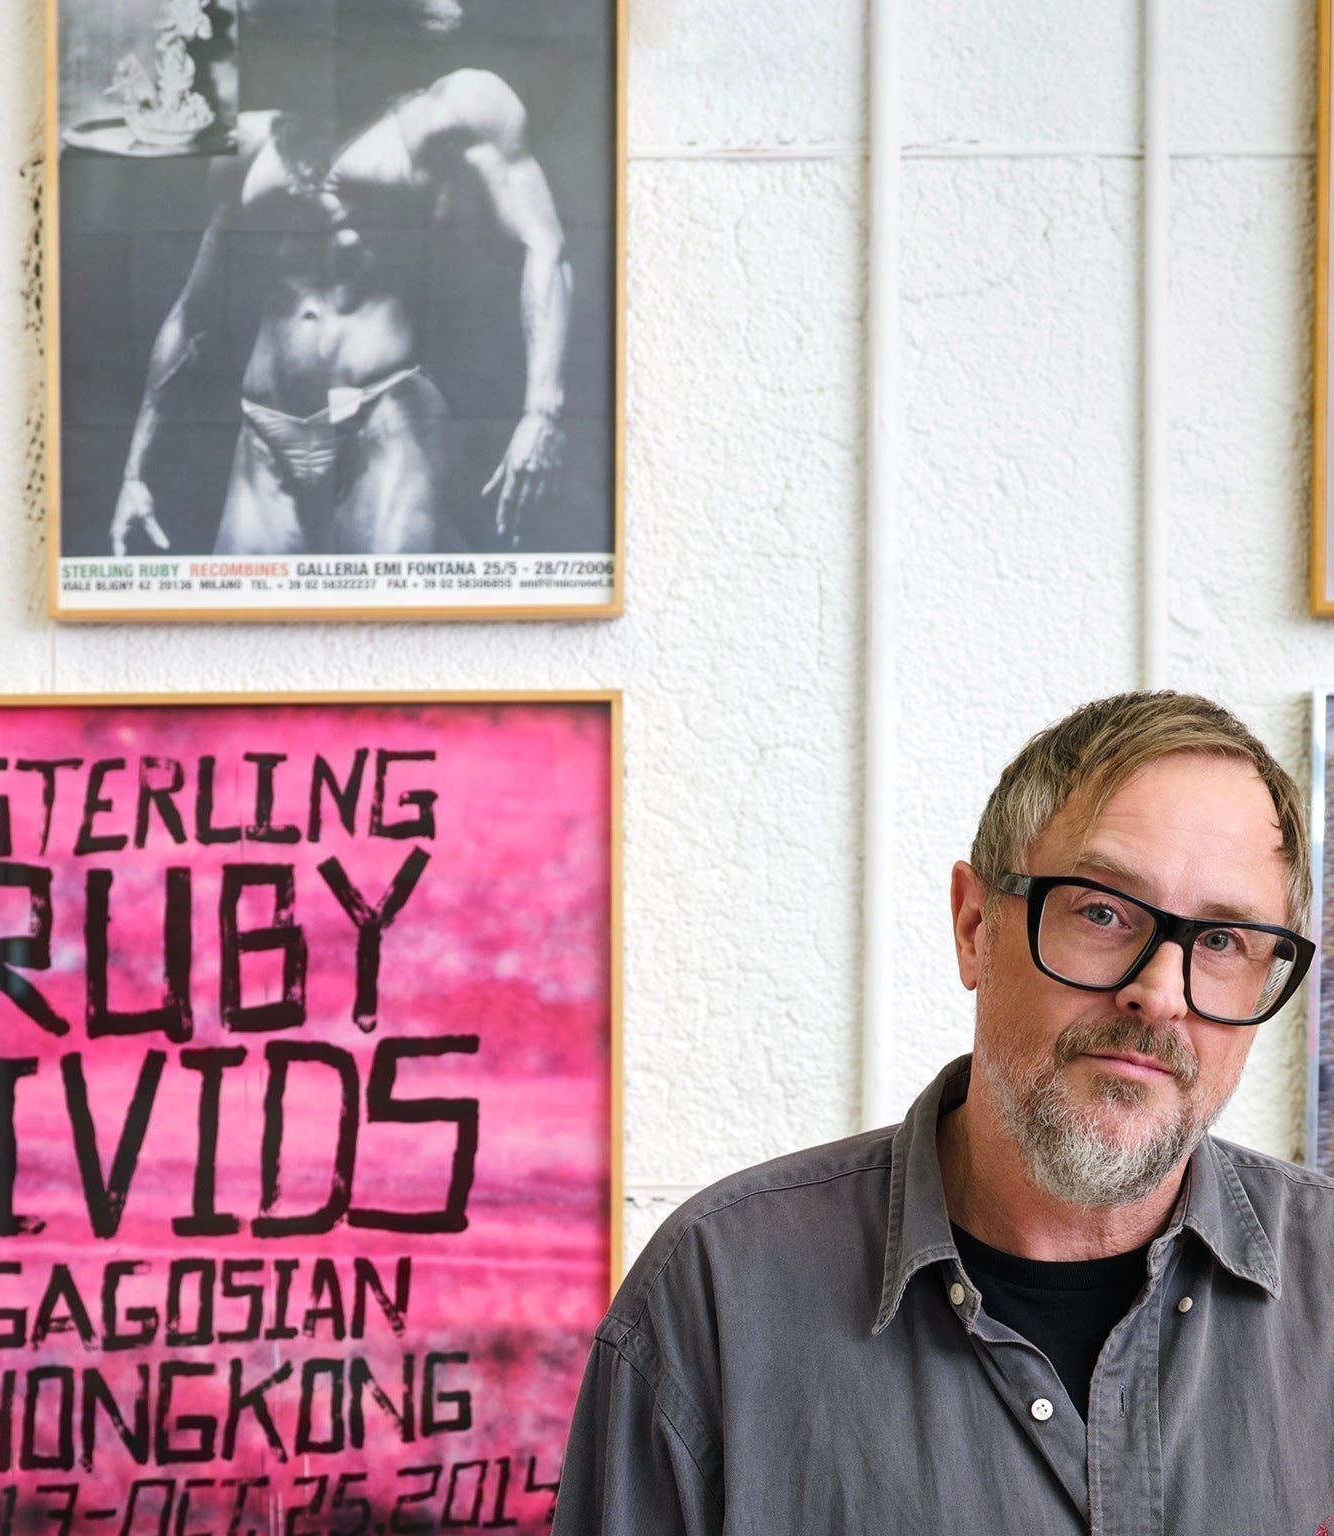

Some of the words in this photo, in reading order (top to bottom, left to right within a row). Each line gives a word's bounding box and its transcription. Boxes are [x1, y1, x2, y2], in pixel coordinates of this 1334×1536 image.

[62, 563, 134, 579] STERLING
[139, 562, 179, 578] RUBY
[189, 562, 289, 577] RECOMBINES
[296, 561, 368, 577] GALLERIA
[374, 561, 403, 576] EMI
[407, 561, 476, 576] FONTANA
[483, 561, 517, 576] 25/5
[534, 560, 615, 576] 28/7/2006
[200, 579, 242, 590] MILANO
